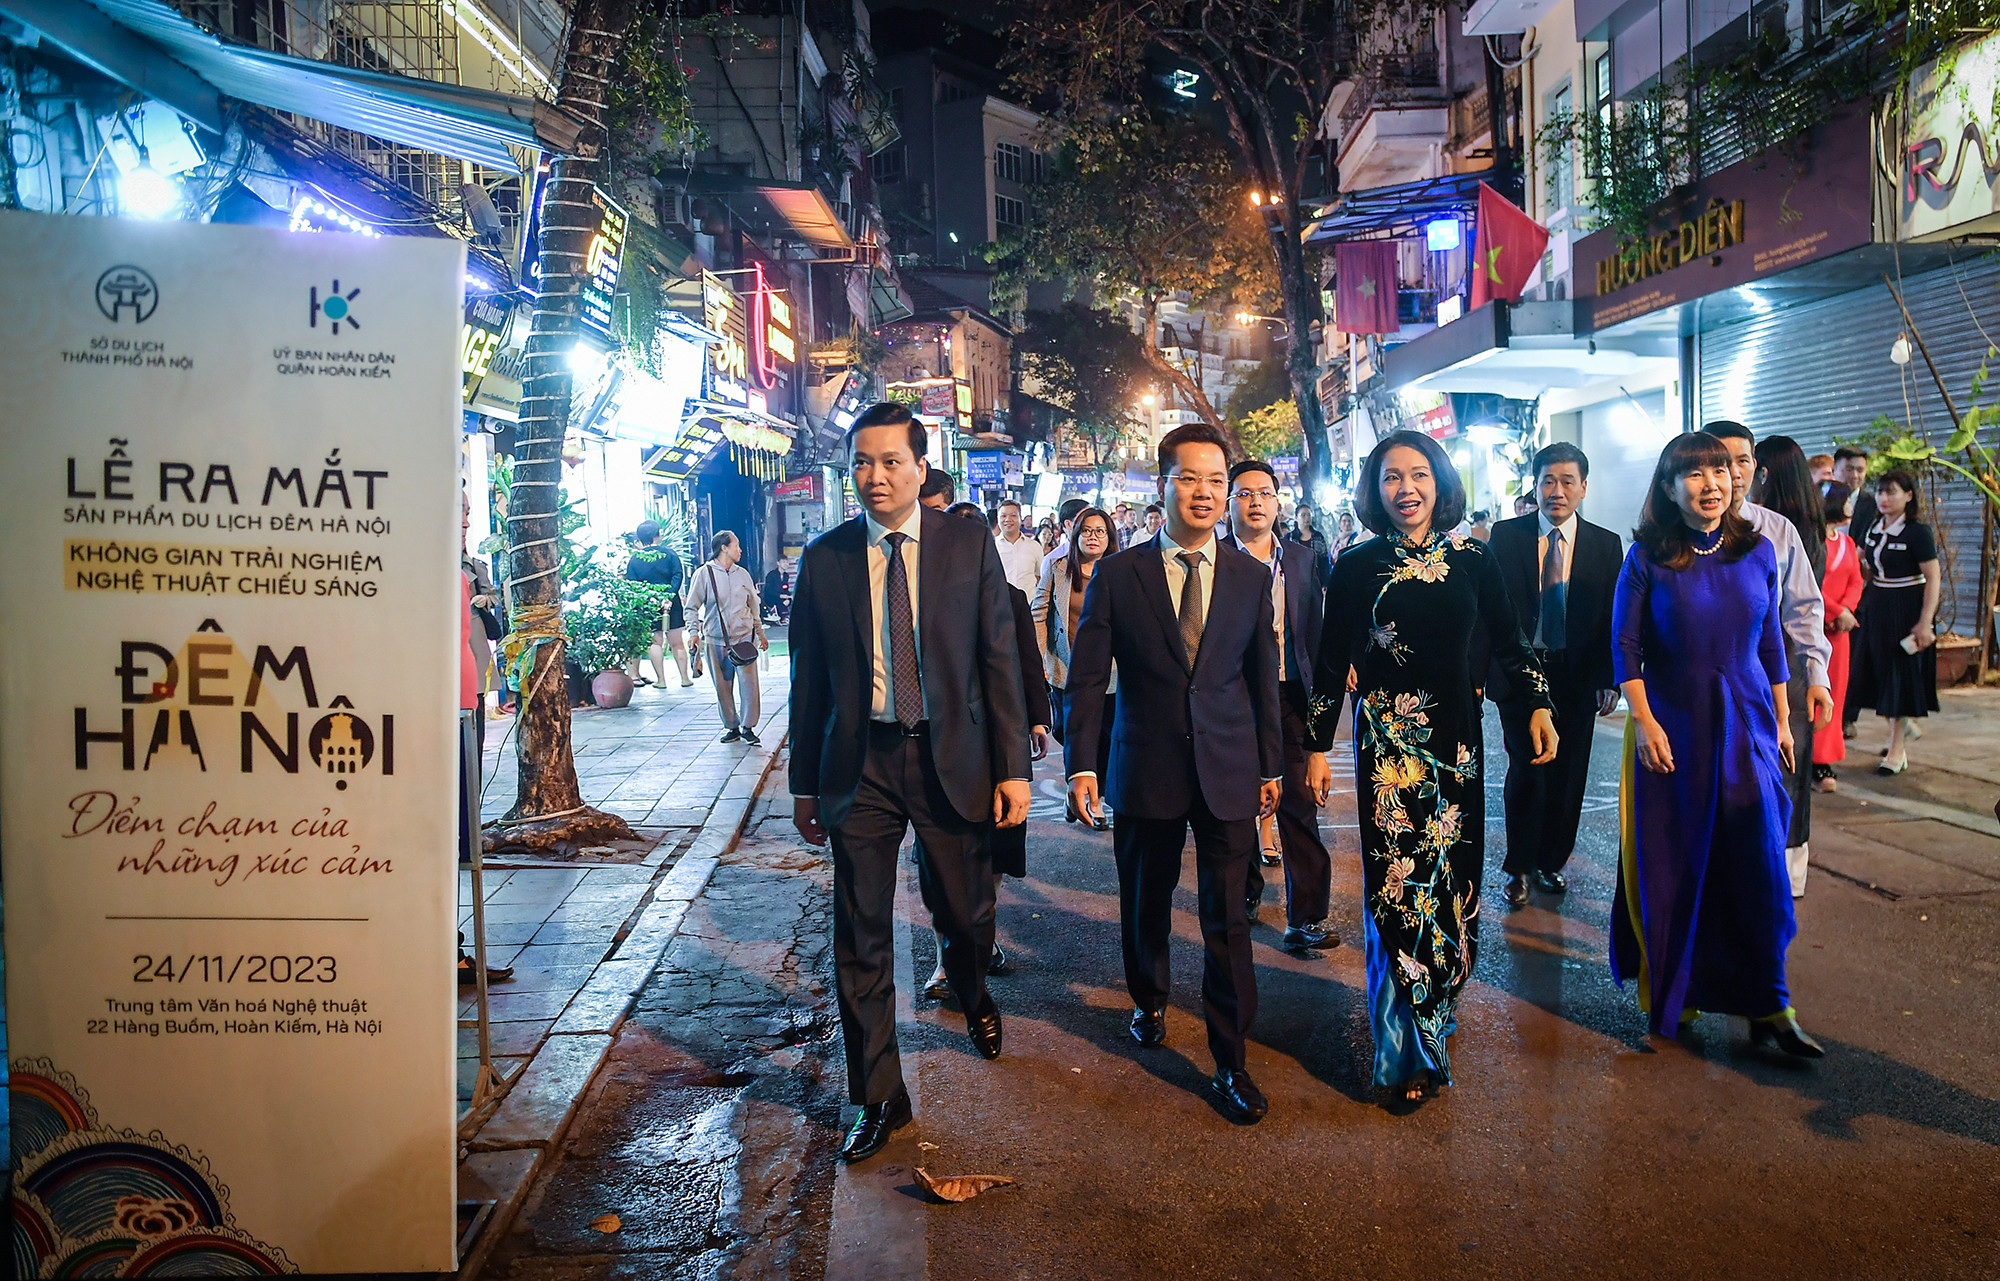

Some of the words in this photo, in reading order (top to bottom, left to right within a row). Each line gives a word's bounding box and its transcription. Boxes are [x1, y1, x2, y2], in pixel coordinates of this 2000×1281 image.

[1679, 197, 1745, 268] DIỆN
[61, 350, 110, 365] THÀNH
[113, 349, 143, 367] PHỐ
[146, 351, 167, 368] HÀ
[169, 354, 194, 370] NỘI
[90, 336, 109, 351] SỞ
[112, 340, 131, 352] DU
[133, 341, 164, 354] LỊCH
[295, 349, 323, 362] BAN
[327, 350, 364, 364] NHÂN
[367, 351, 396, 364] DÂN
[277, 361, 314, 377] QUẬN
[319, 363, 356, 377] HOÀN
[360, 362, 391, 379] KIẾM
[66, 438, 134, 500] LỄ
[160, 462, 239, 505] RA
[261, 448, 389, 510] MẮT
[63, 505, 105, 523] SẢN
[113, 505, 175, 527] PHẨM
[182, 513, 209, 529] DU
[218, 513, 262, 532] LỊCH
[270, 510, 313, 532] ĐÊM
[321, 512, 349, 533] HÀ
[356, 514, 391, 536] NỘI
[70, 537, 158, 565] KHÔNG
[165, 549, 223, 567] GIAN
[231, 544, 283, 569] TRẢI
[291, 550, 383, 575] NGHIỆM
[76, 566, 145, 592] NGHỆ
[152, 570, 231, 595] THUẬT
[238, 570, 306, 596] CHIẾU
[314, 575, 378, 597] SÁNG
[115, 618, 319, 708] ĐÊM
[240, 695, 394, 791] NỘI
[61, 790, 165, 839] Điểm
[177, 801, 278, 842] chạm
[291, 807, 350, 837] của
[117, 839, 240, 887] những
[243, 848, 309, 882] xúc
[321, 845, 395, 876] cảm
[132, 954, 338, 984] 24/11/2023
[106, 999, 154, 1016] Trung
[160, 999, 193, 1014] tâm
[198, 998, 230, 1014] Văn
[235, 999, 267, 1014] hoá
[272, 1000, 317, 1016] Nghệ
[322, 999, 368, 1016] thuật
[87, 1020, 109, 1034] 22
[114, 1019, 160, 1037] Hàng
[165, 1019, 219, 1036] Buồm,
[224, 1021, 270, 1034] Hoàn
[275, 1018, 322, 1037] Kiếm,
[326, 1020, 350, 1035] Hà
[354, 1020, 382, 1037] Nội
